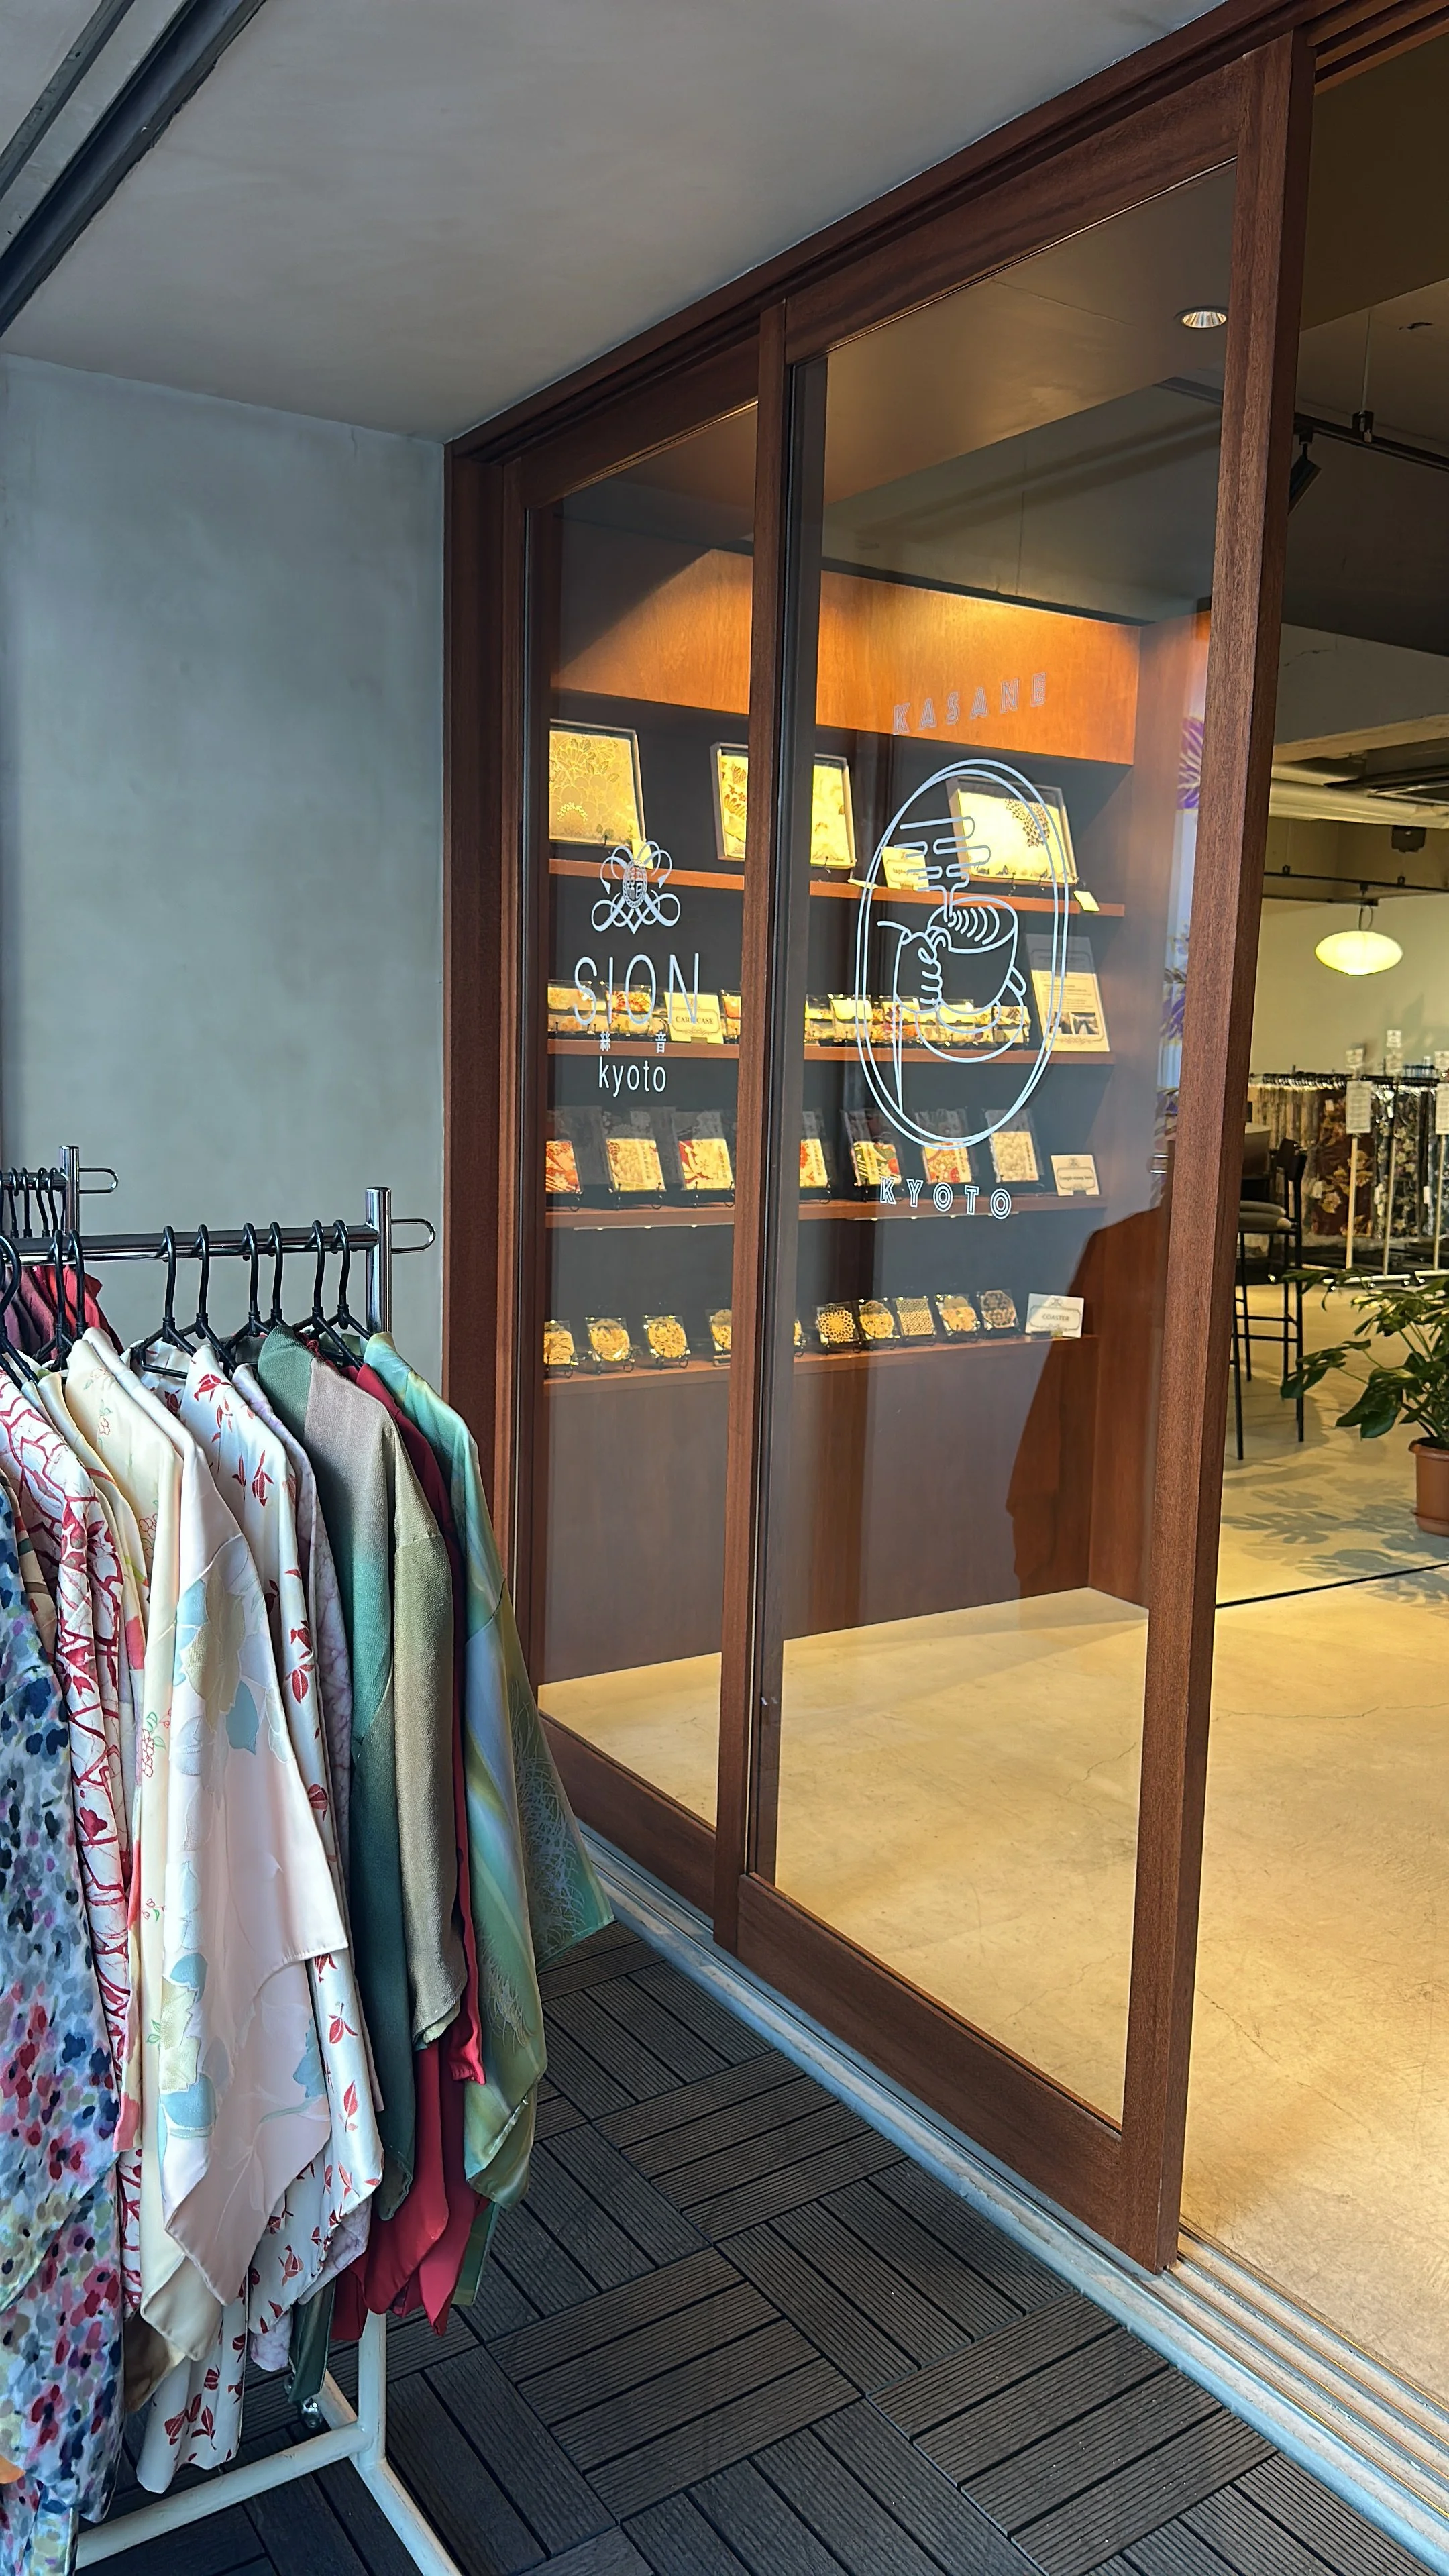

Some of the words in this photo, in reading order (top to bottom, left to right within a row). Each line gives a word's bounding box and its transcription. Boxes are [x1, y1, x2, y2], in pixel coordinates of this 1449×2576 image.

[893, 672, 1047, 735] KASANE
[574, 953, 699, 1026] SION
[598, 1055, 666, 1097] kyoto
[879, 1175, 1012, 1220] KYOTO
[1042, 1313, 1070, 1322] COASTER
